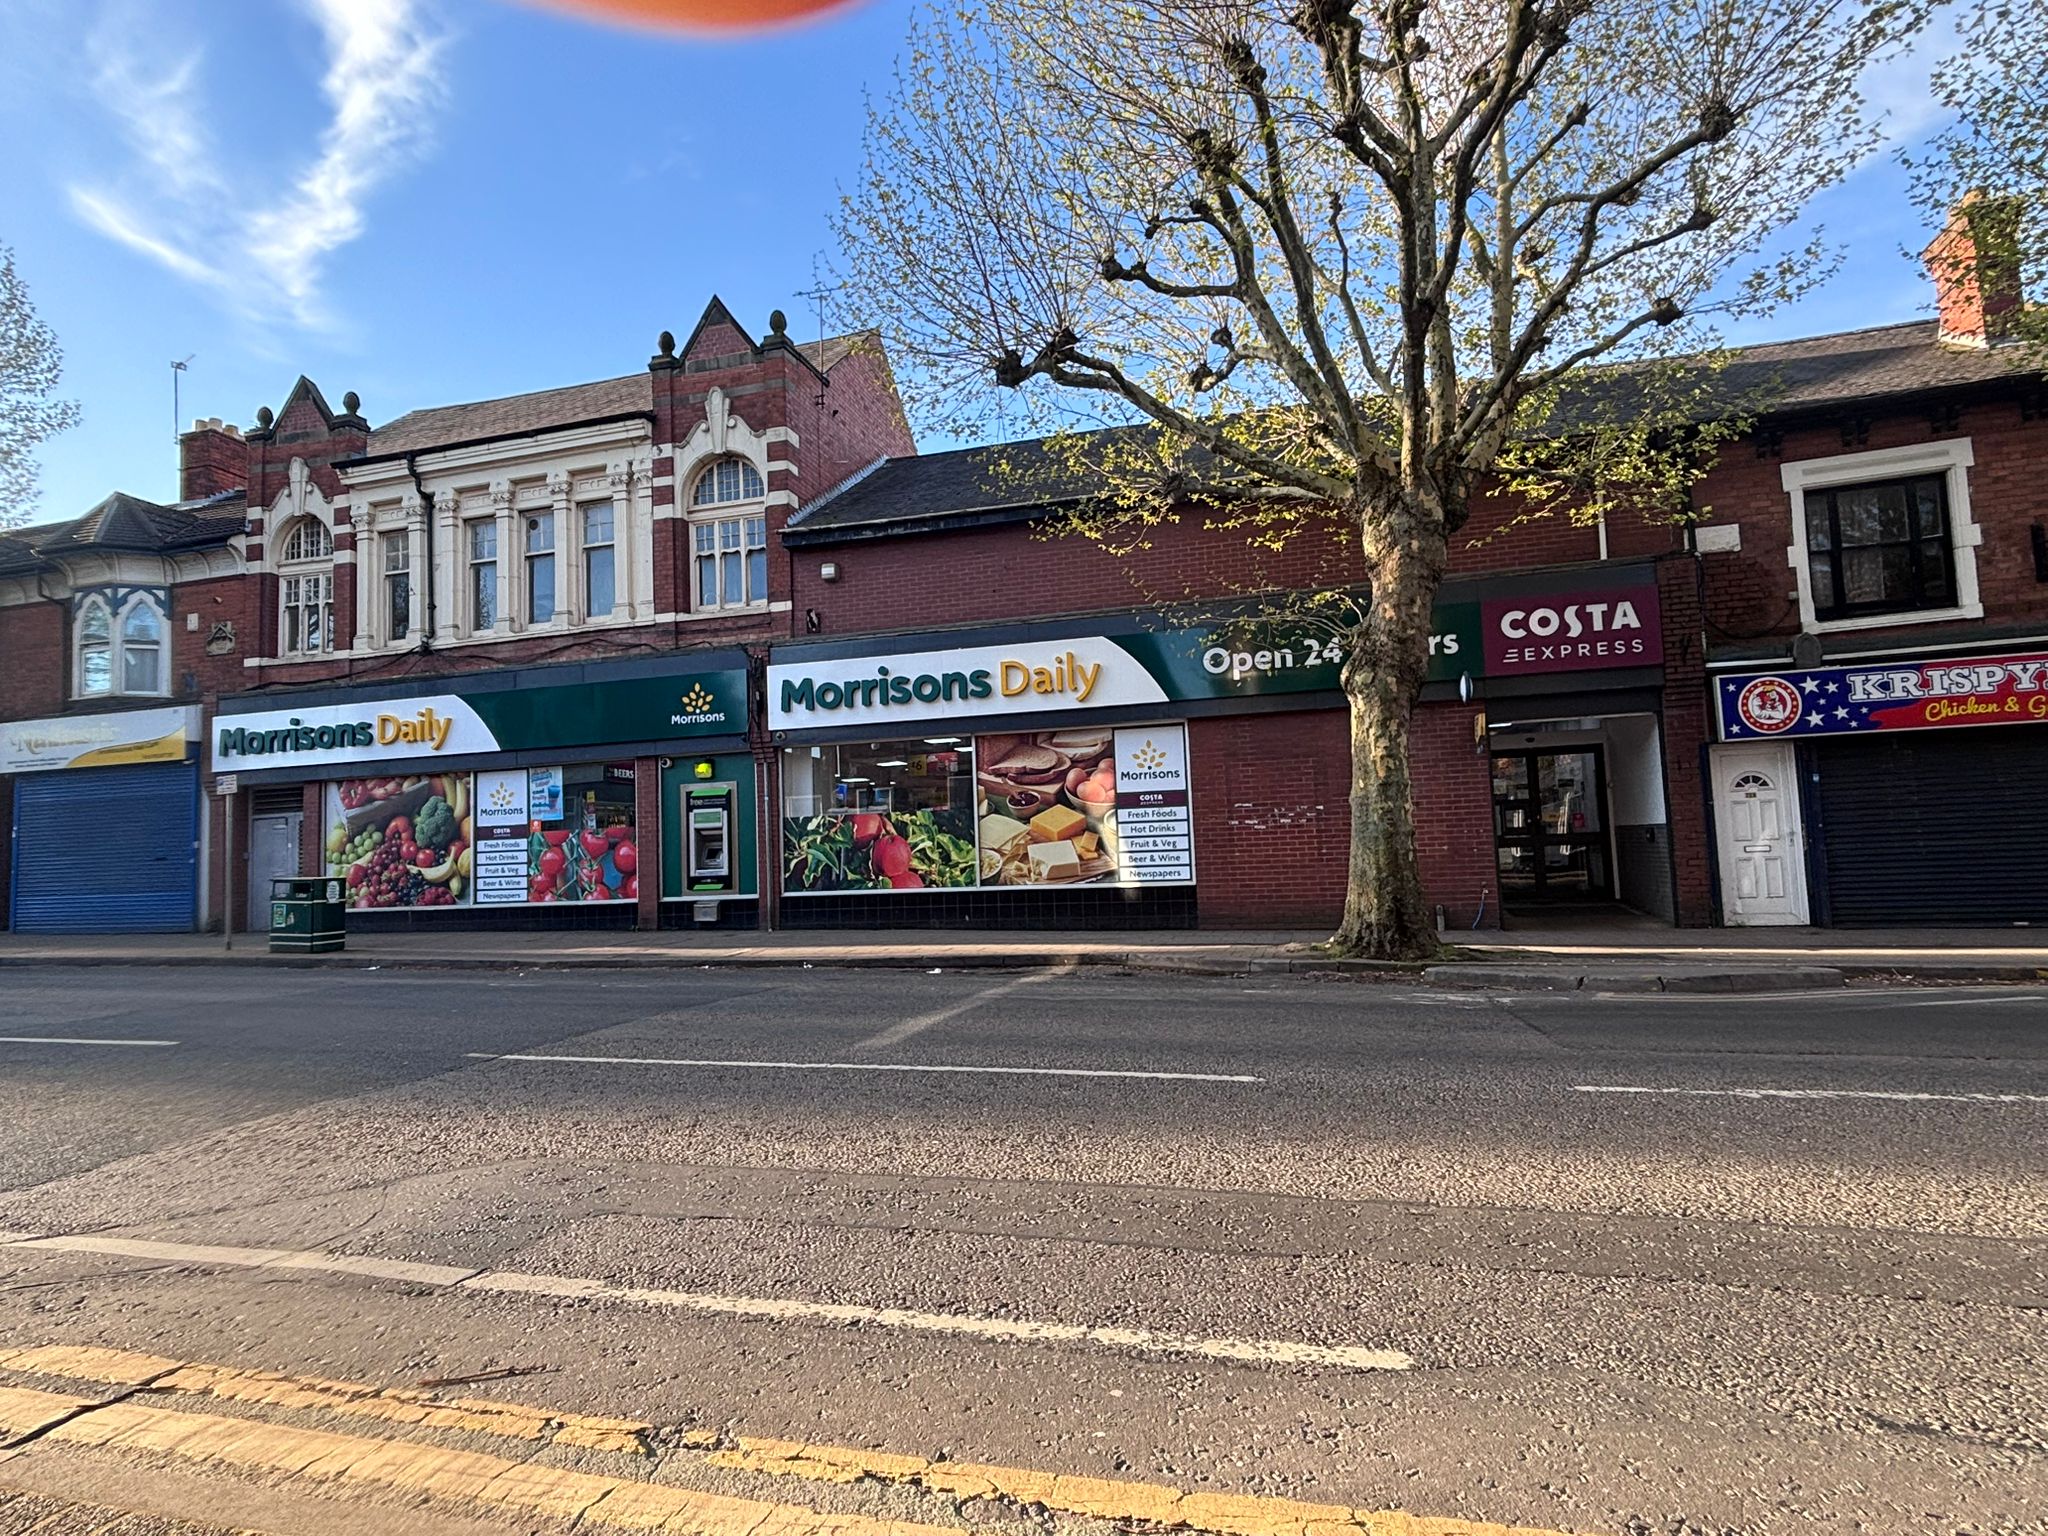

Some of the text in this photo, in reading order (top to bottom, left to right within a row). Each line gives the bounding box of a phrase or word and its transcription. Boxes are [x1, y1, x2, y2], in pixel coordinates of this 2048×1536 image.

[1500, 600, 1642, 639] COSTA
[1524, 639, 1644, 662] EXPRESS
[1202, 637, 1343, 681] Open 24
[780, 652, 1101, 713] Morrisons Daily
[1846, 660, 2048, 702] KRISPY
[1925, 695, 2048, 721] Chicken & G
[671, 708, 726, 725] Morrisons
[219, 708, 453, 757] Morrisons Daily
[1120, 765, 1181, 781] Morrisons
[1139, 794, 1164, 802] COSTA
[480, 803, 524, 817] Morrisons
[1127, 809, 1177, 819] Fresh Foods
[1130, 823, 1176, 834] Hot Drinks
[1130, 839, 1178, 849] Fruit & Veg
[1128, 853, 1181, 863] Beer & Wine
[507, 867, 519, 875] Veg
[1129, 869, 1181, 879] Newspapers
[483, 892, 521, 900] Newspapers
